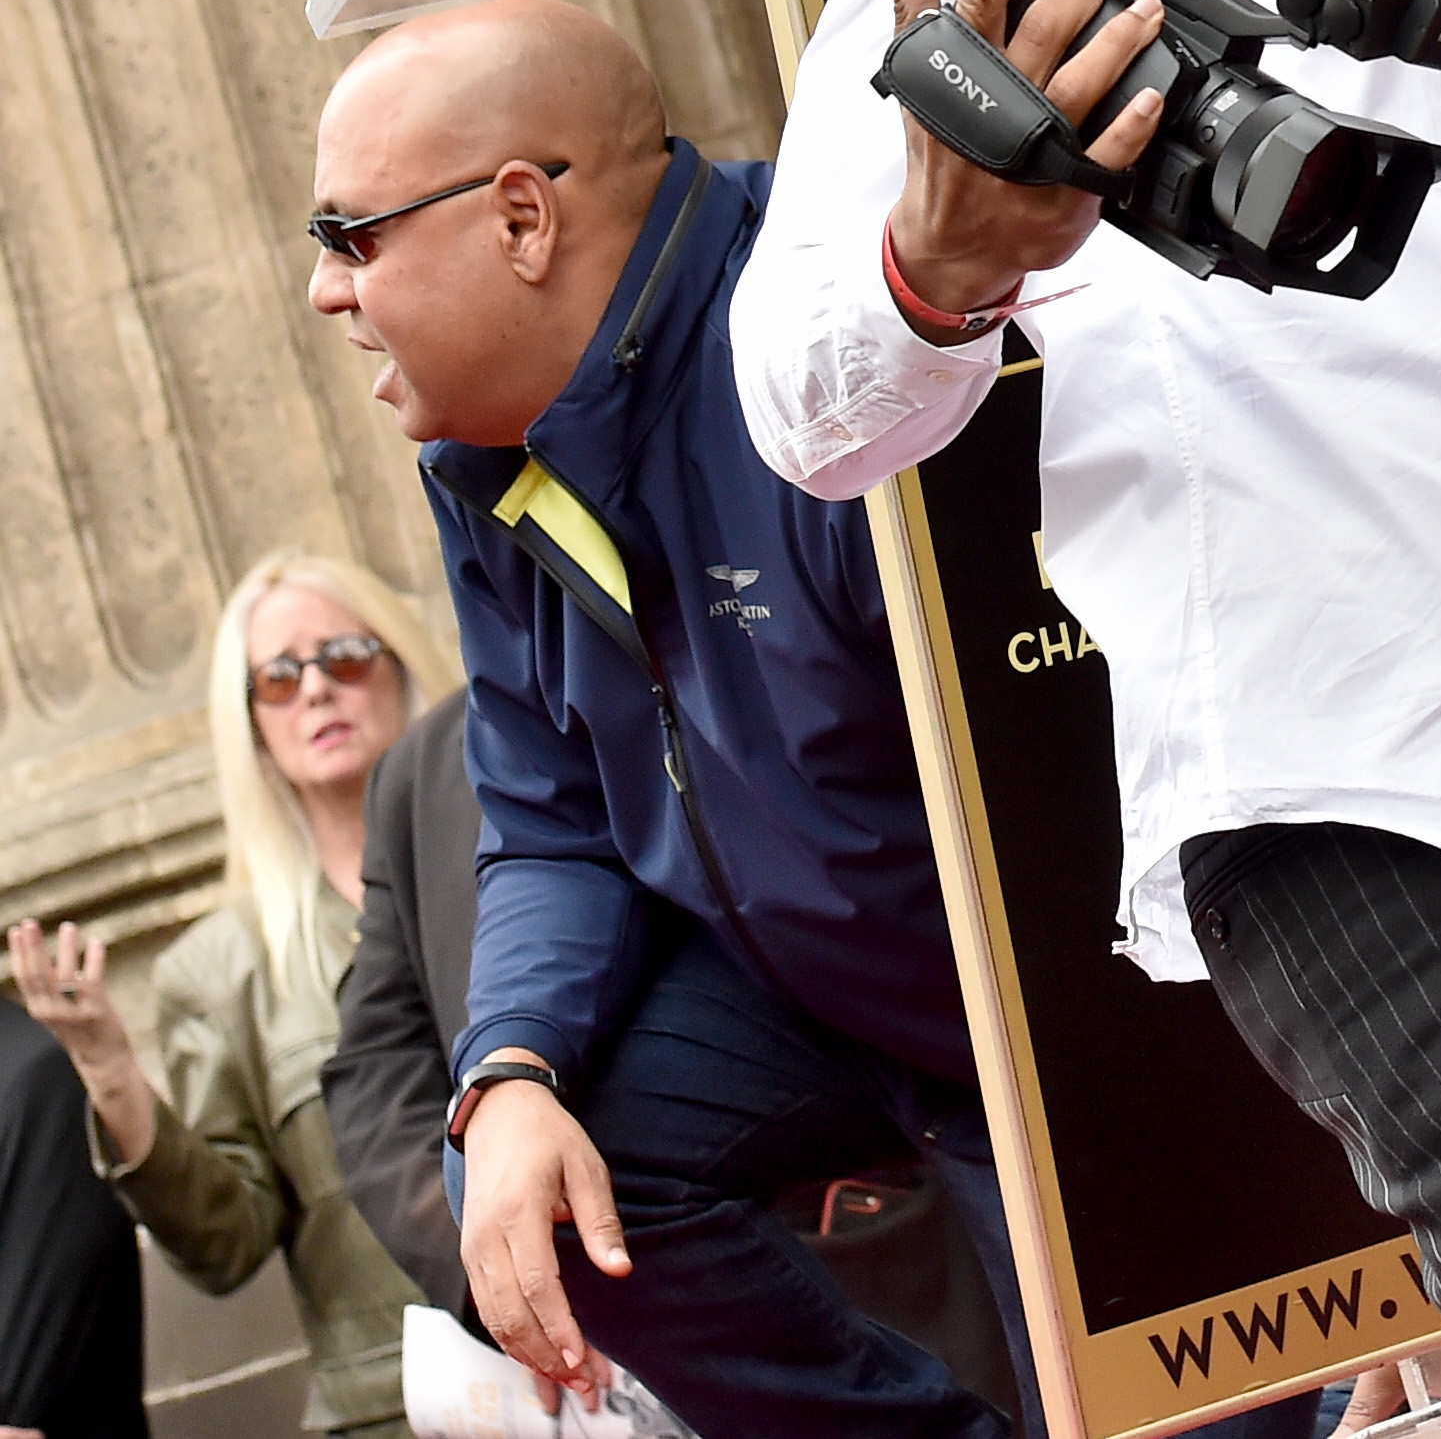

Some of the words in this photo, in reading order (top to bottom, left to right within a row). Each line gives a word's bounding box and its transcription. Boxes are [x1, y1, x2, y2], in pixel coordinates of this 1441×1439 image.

[928, 49, 999, 113] SONY
[709, 599, 742, 618] ASTO
[1147, 1253, 1430, 1388] WWW.
